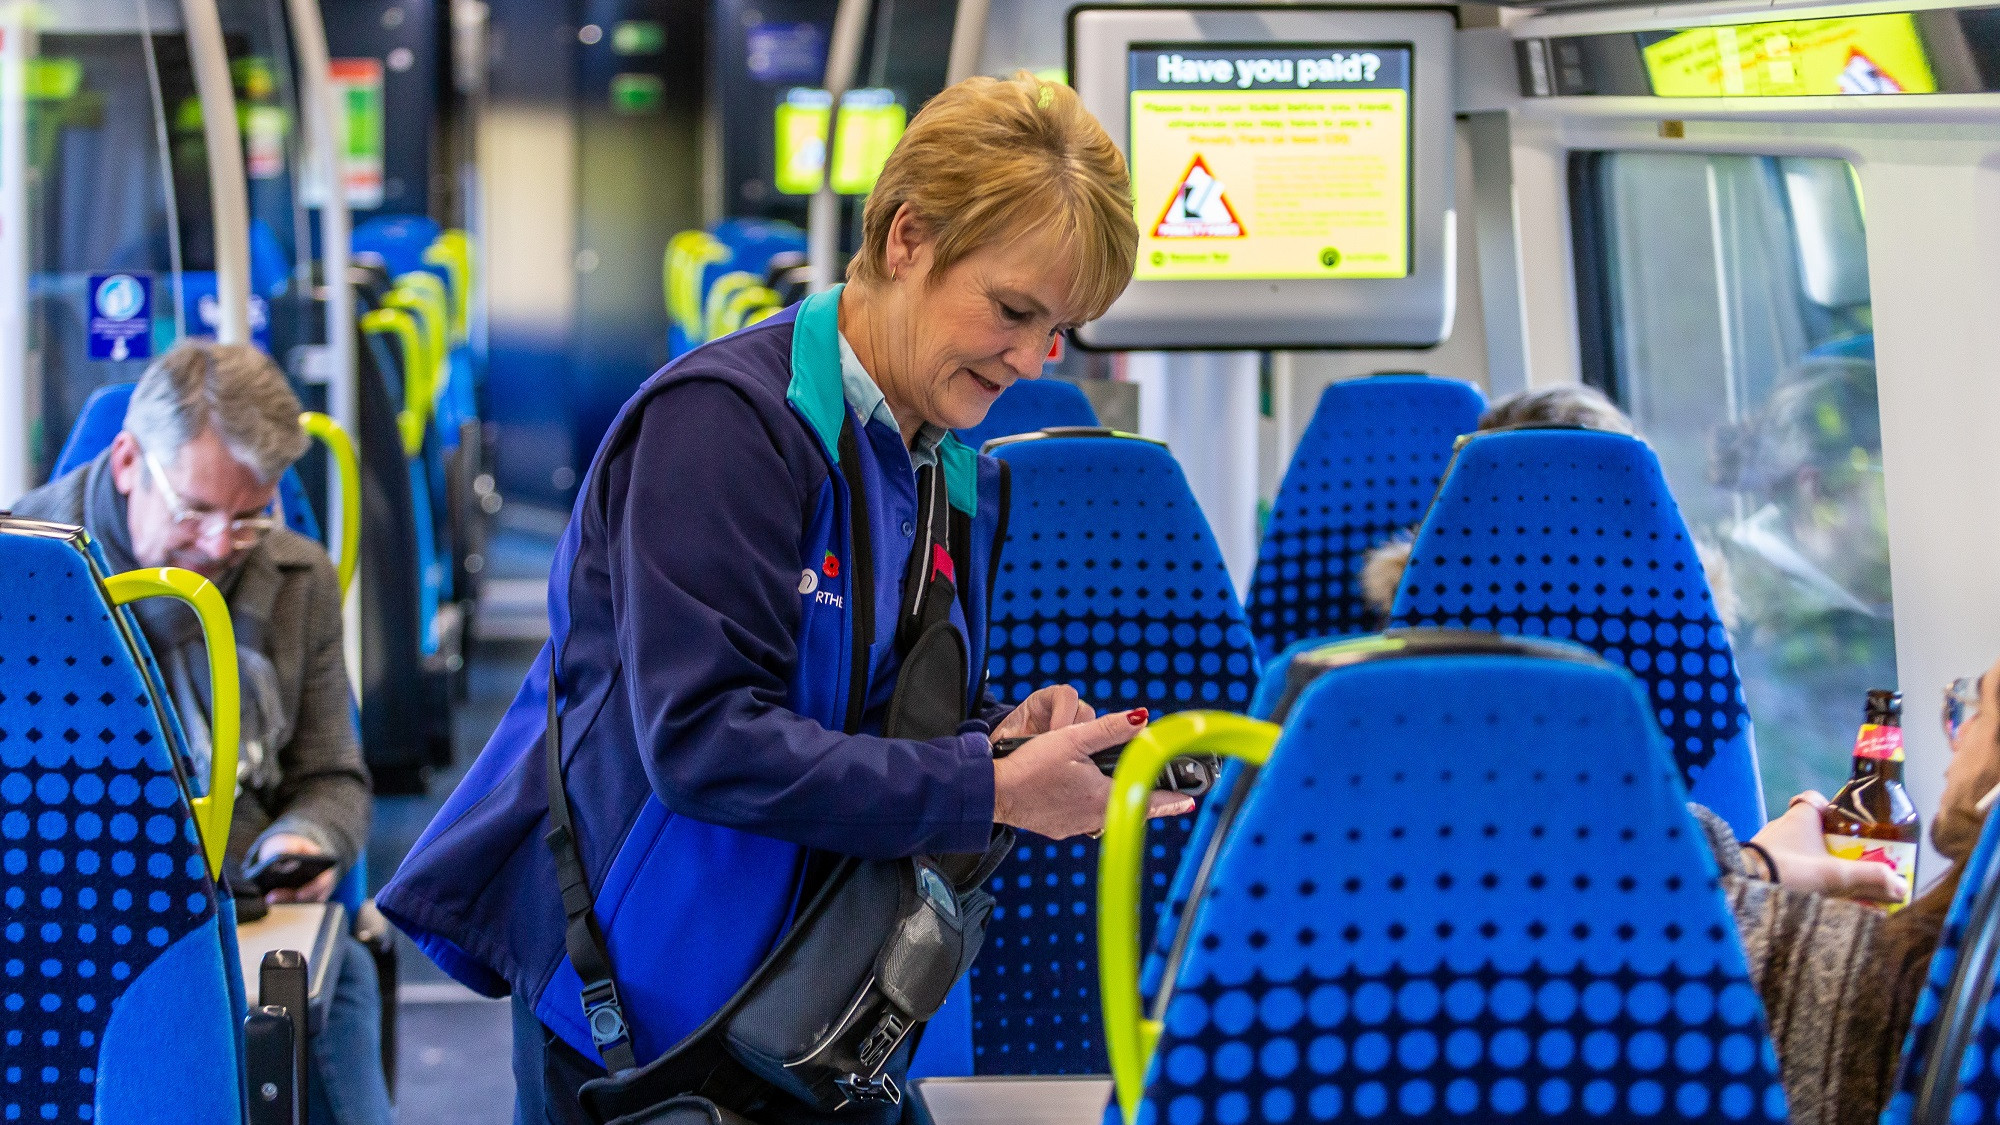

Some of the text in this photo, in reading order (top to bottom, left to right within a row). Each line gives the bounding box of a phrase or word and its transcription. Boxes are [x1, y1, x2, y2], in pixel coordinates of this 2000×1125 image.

[1157, 53, 1381, 89] Have you paid?
